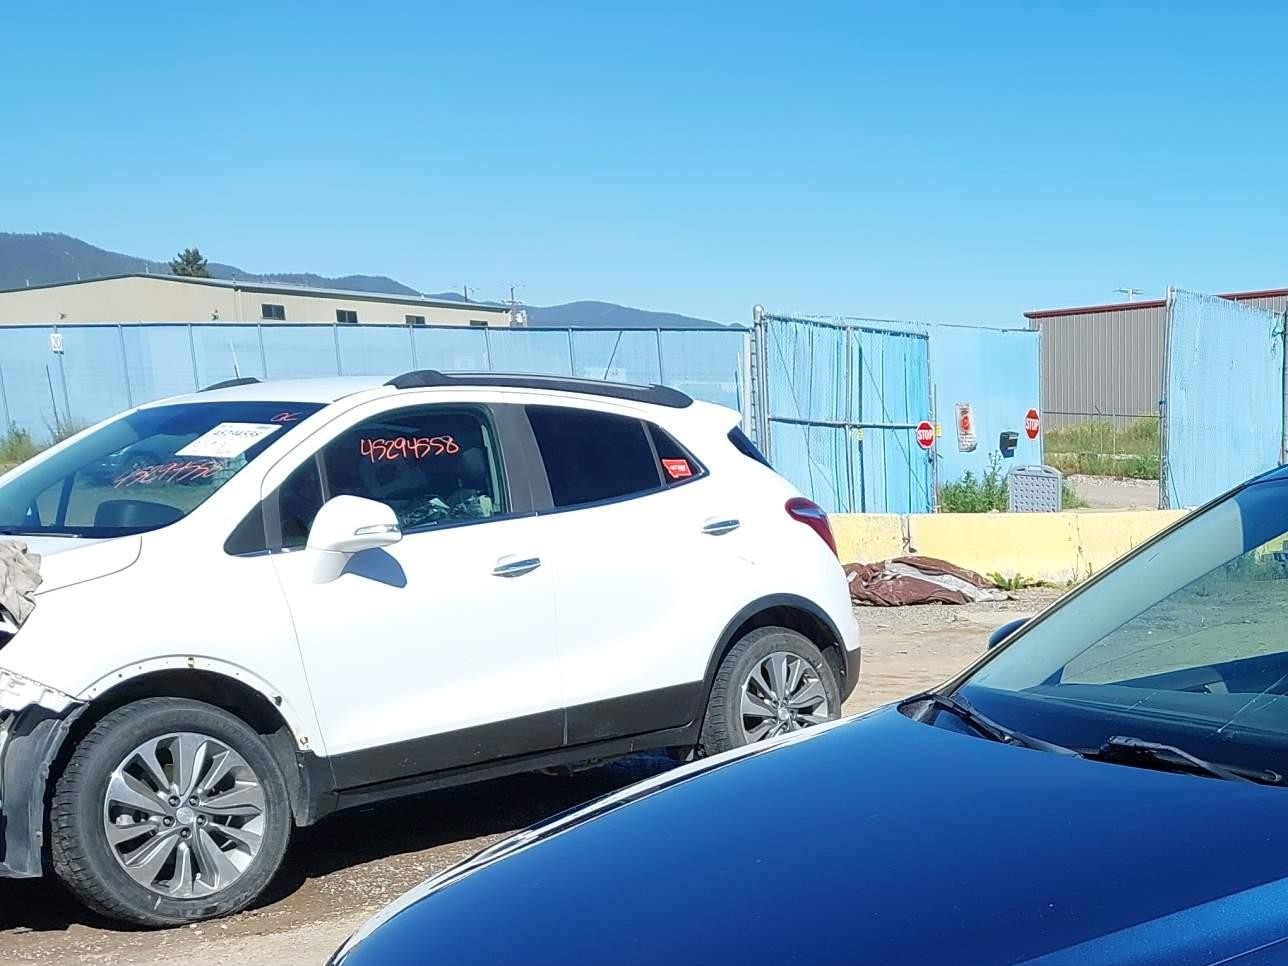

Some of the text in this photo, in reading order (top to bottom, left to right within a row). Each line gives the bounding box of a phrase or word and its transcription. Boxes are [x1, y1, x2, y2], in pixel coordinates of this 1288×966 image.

[1025, 418, 1039, 431] STOP
[917, 429, 933, 441] STOP
[361, 435, 459, 463] 45294558
